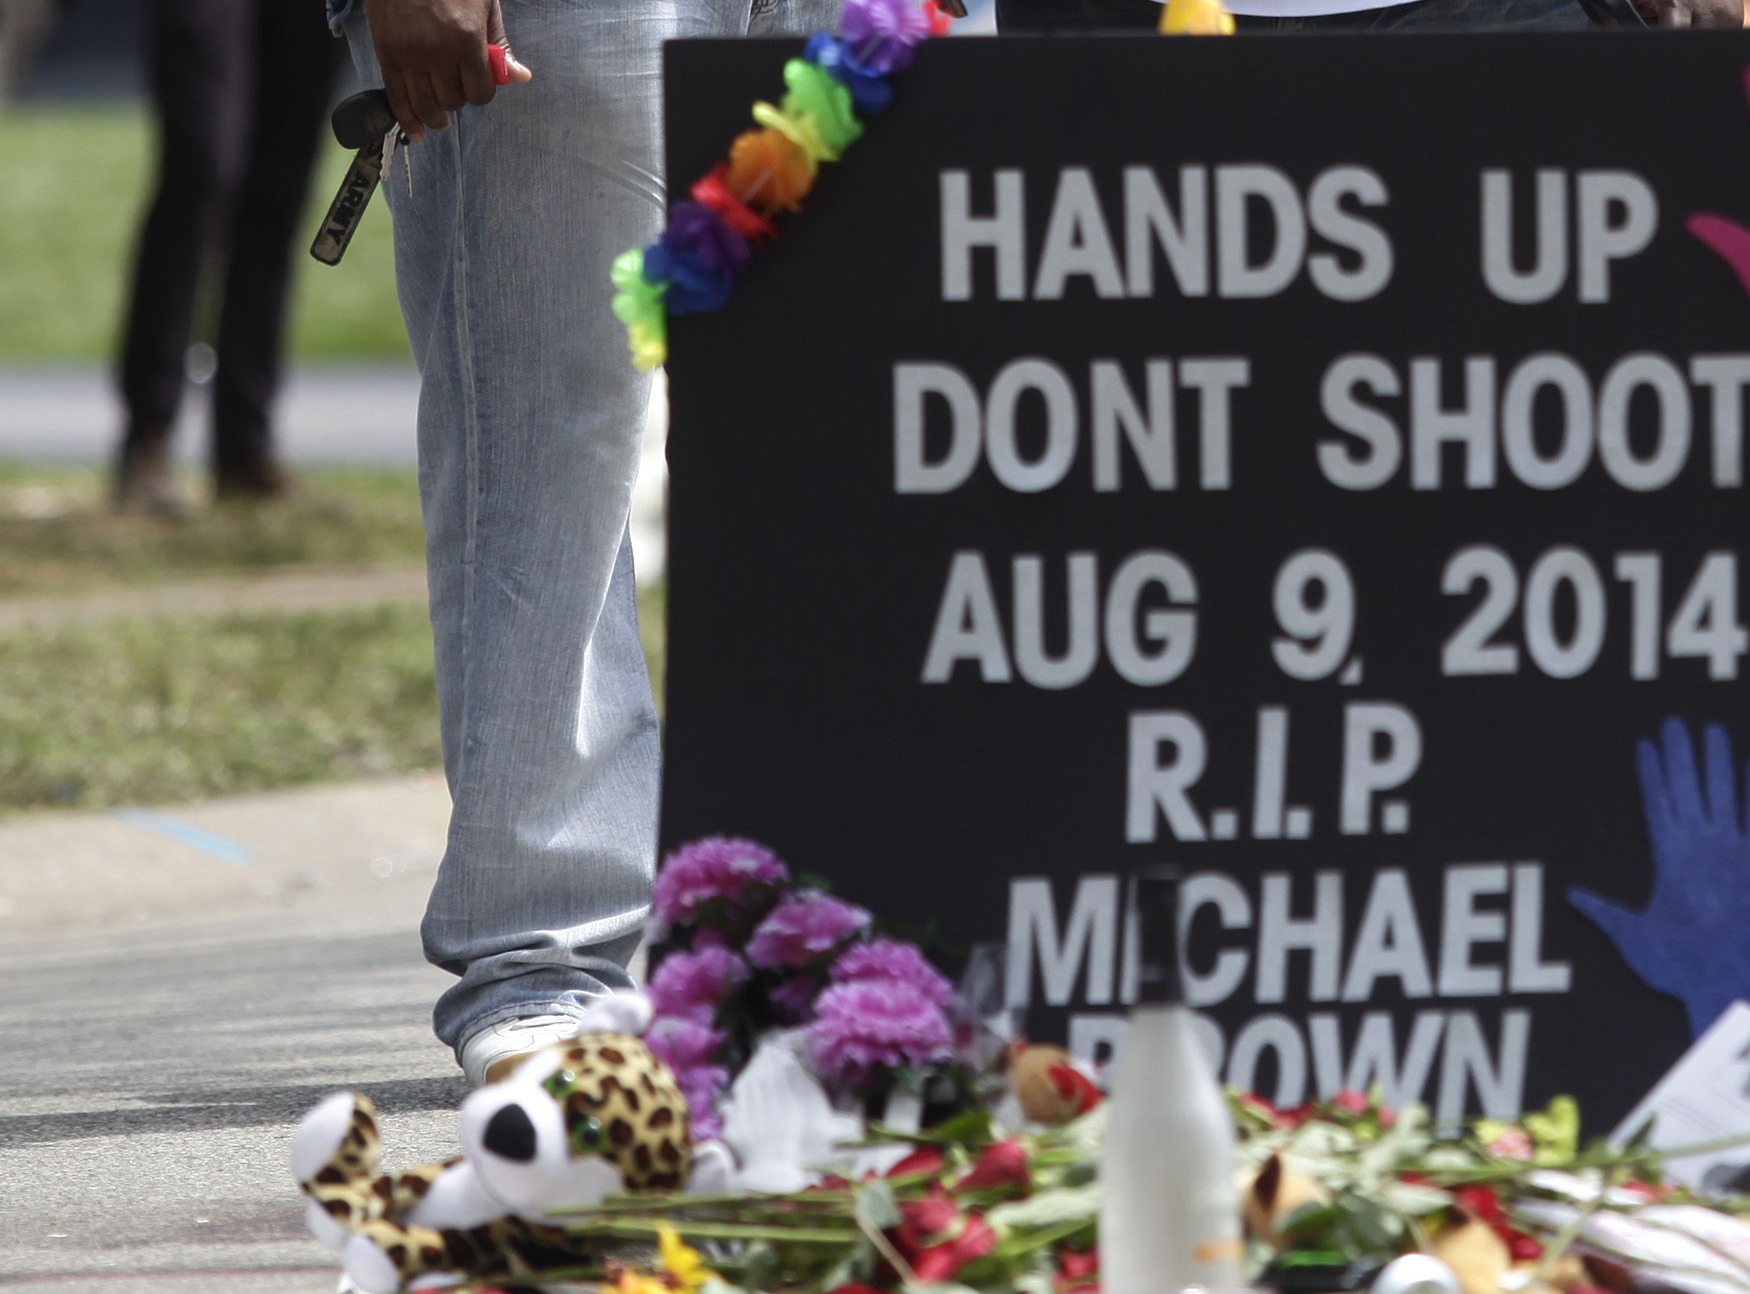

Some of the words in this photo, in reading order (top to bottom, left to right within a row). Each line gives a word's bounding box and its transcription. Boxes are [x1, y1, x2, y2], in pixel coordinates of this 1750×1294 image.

[326, 169, 371, 247] ARMY
[940, 164, 1394, 302] HANDS
[1480, 168, 1659, 304] UP
[893, 356, 1251, 494] DONT
[921, 549, 1198, 690] AUG
[1441, 545, 1750, 682] 2014
[1125, 702, 1422, 843] R.I.P.
[1067, 1010, 1530, 1138] OWN
